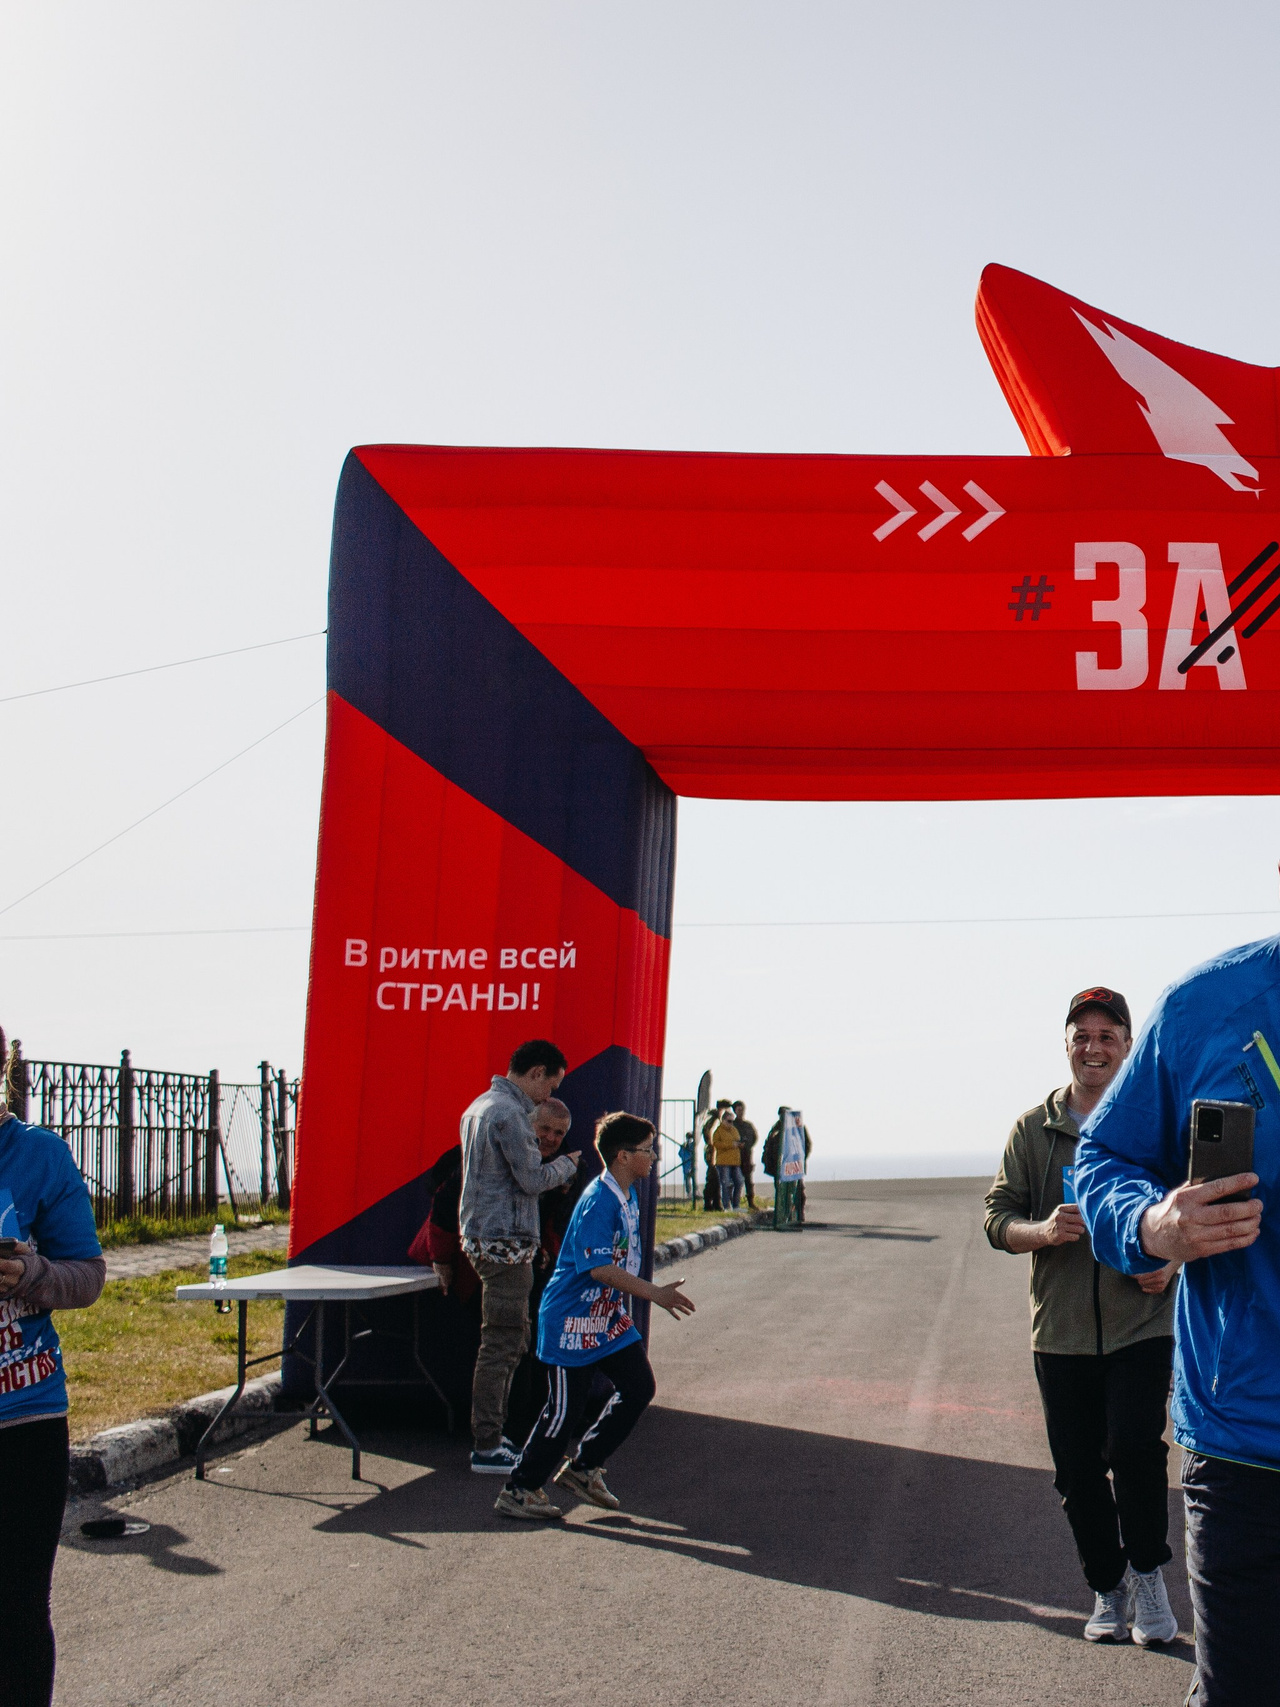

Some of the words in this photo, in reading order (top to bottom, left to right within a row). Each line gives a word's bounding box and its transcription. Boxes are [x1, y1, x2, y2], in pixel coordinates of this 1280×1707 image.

[344, 938, 368, 967] В
[379, 946, 488, 973] ритме
[500, 941, 577, 969] всей
[376, 981, 541, 1011] СТРАНЫ!
